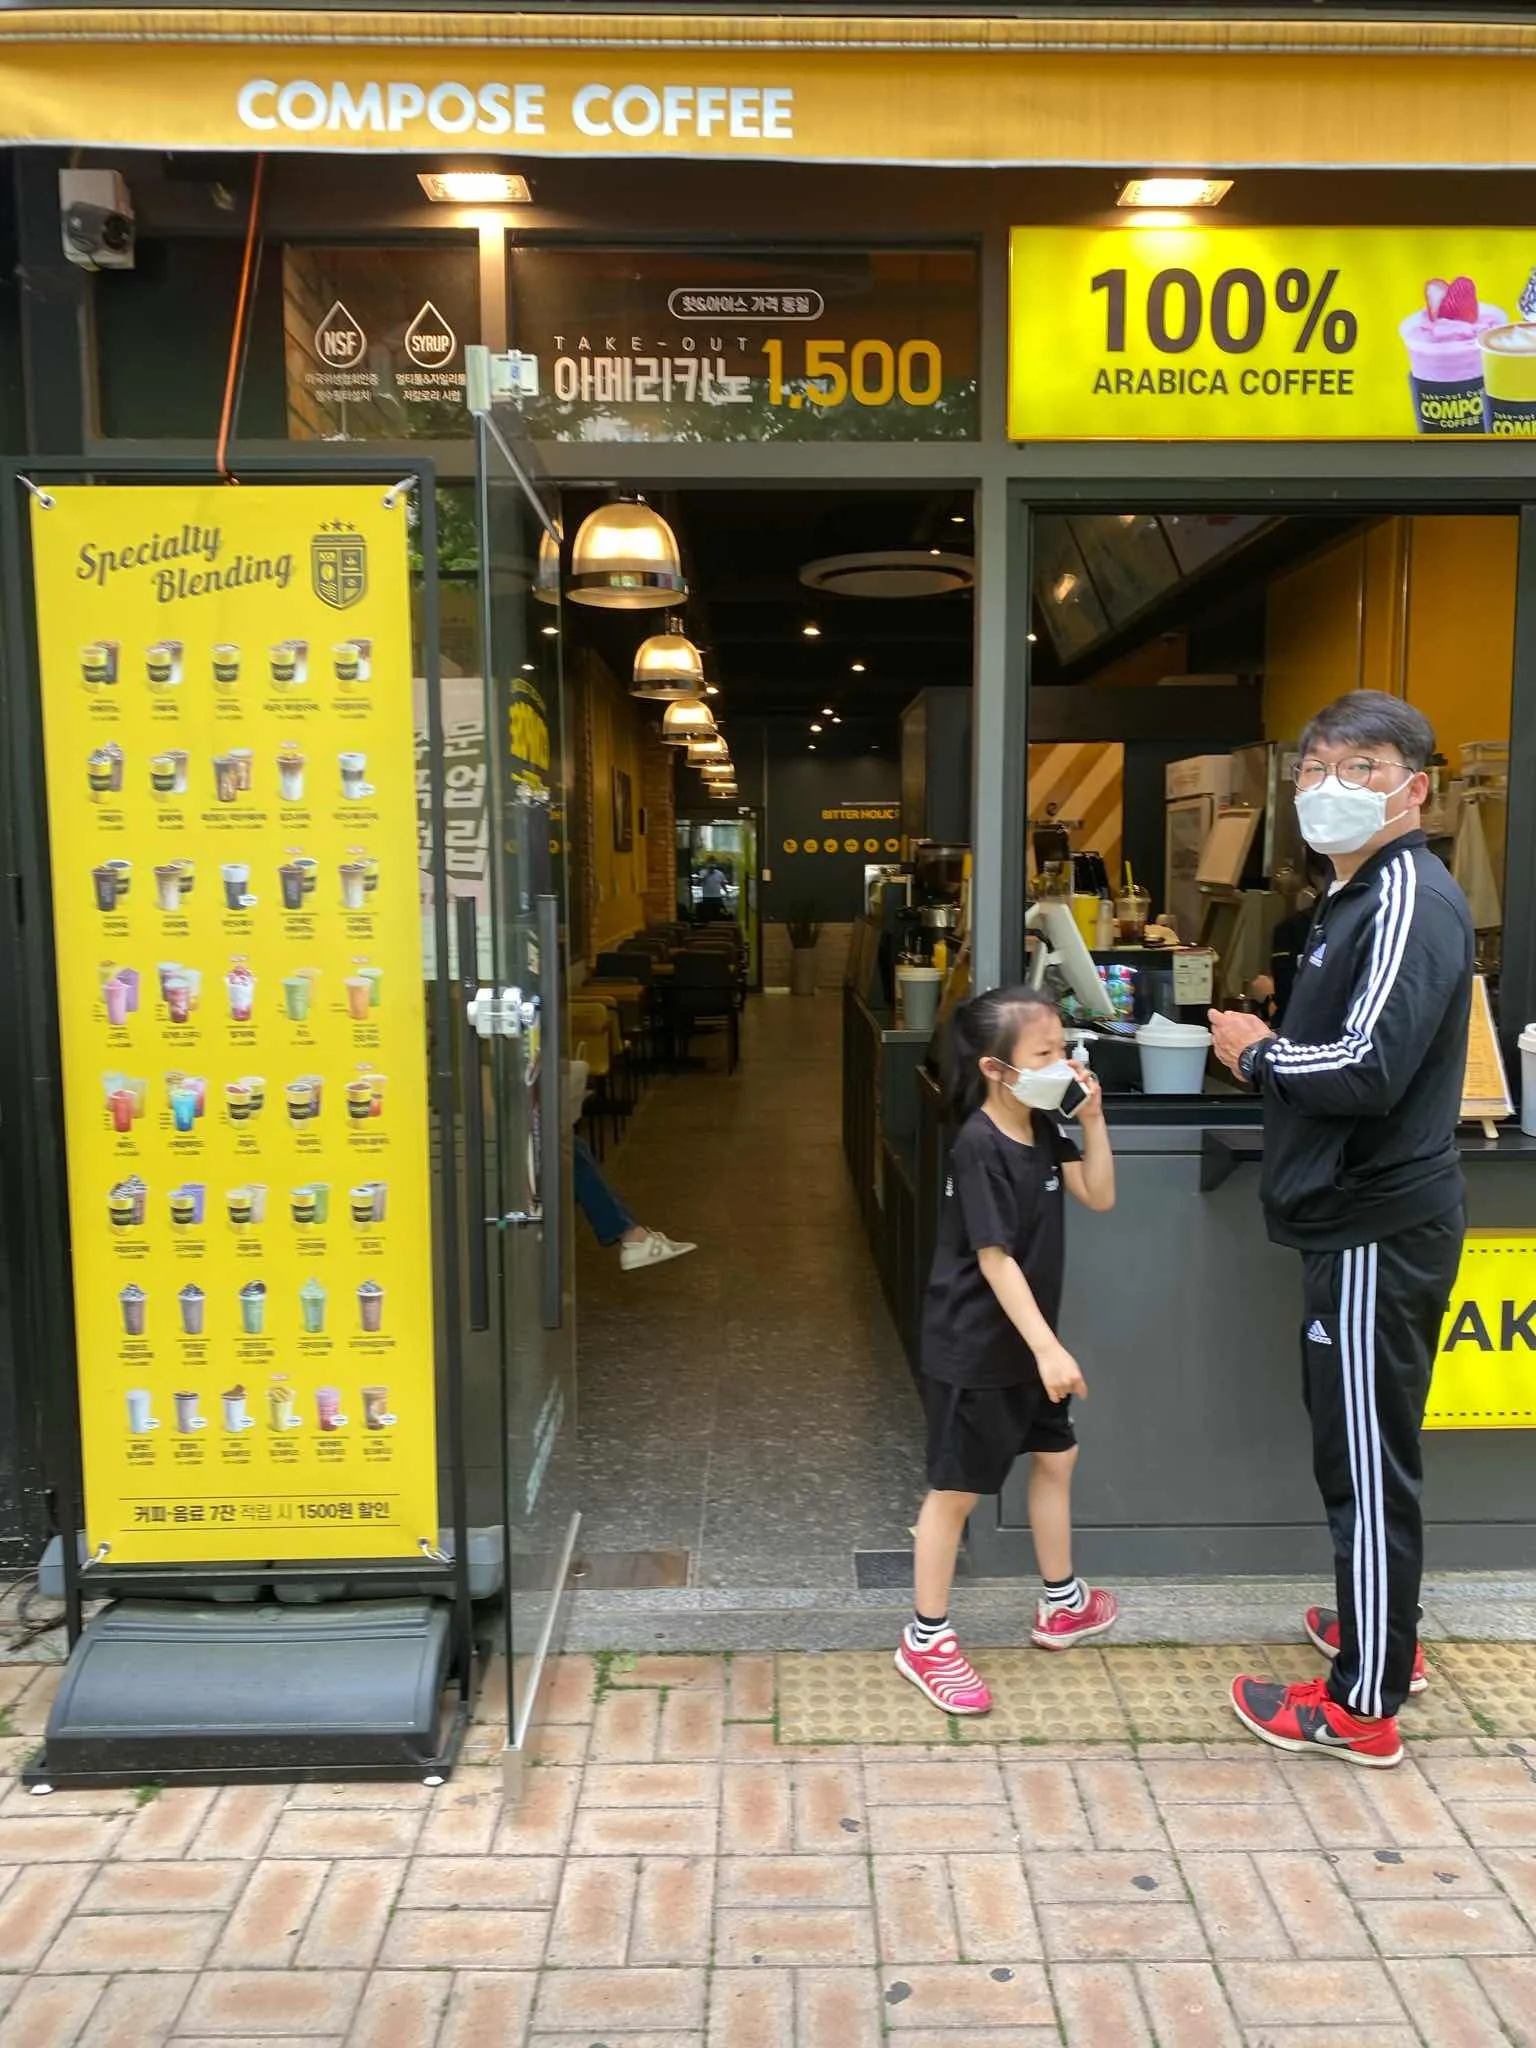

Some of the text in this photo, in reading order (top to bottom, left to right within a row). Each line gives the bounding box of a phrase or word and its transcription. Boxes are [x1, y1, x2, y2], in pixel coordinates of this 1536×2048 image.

[236, 79, 795, 139] COMPOSE COFFEE
[751, 296, 779, 313] 가격
[781, 296, 810, 314] 동일
[1090, 266, 1358, 355] 100%
[324, 331, 358, 356] NSF
[411, 335, 450, 353] SYRUP
[553, 335, 750, 352] TAKE-OUT
[554, 355, 754, 402] 아메리카노
[1092, 368, 1355, 395] ARABICA COFFEE
[76, 524, 222, 586] Specialty
[151, 554, 293, 603] Blending
[822, 809, 860, 819] BITTER
[1443, 1300, 1536, 1352] AK
[210, 1505, 236, 1522] 7잔
[240, 1504, 272, 1521] 적립
[276, 1504, 293, 1520] 시
[298, 1502, 353, 1520] 1500원
[358, 1502, 390, 1519] 할인
